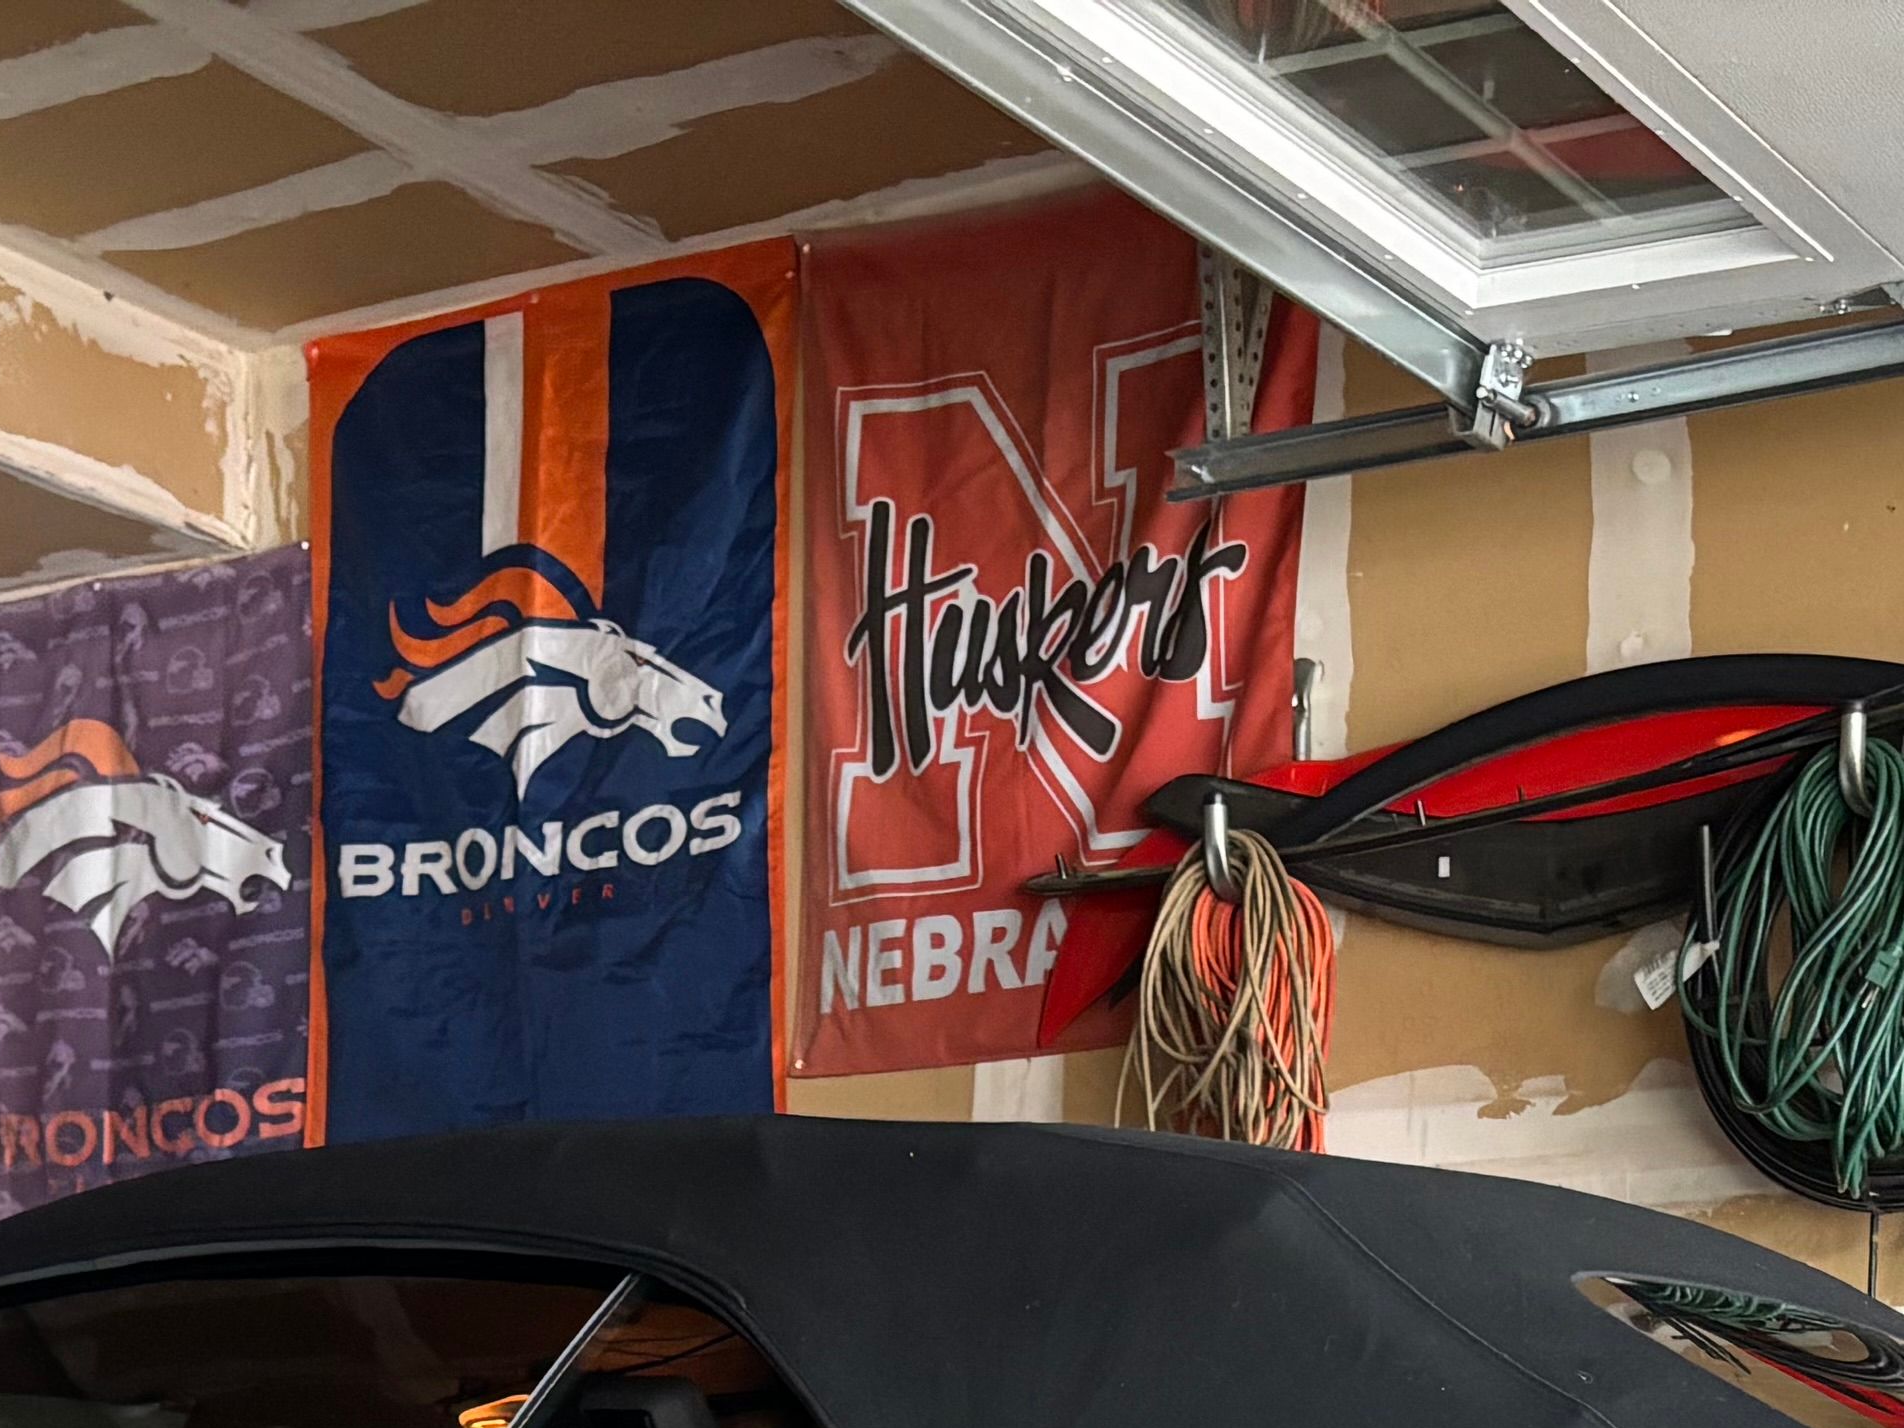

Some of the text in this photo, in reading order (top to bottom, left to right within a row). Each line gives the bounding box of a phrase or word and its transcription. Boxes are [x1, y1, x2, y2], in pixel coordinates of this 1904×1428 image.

[844, 496, 1248, 783] Huskers
[337, 790, 743, 899] BRONCOS
[460, 883, 616, 926] DENVER
